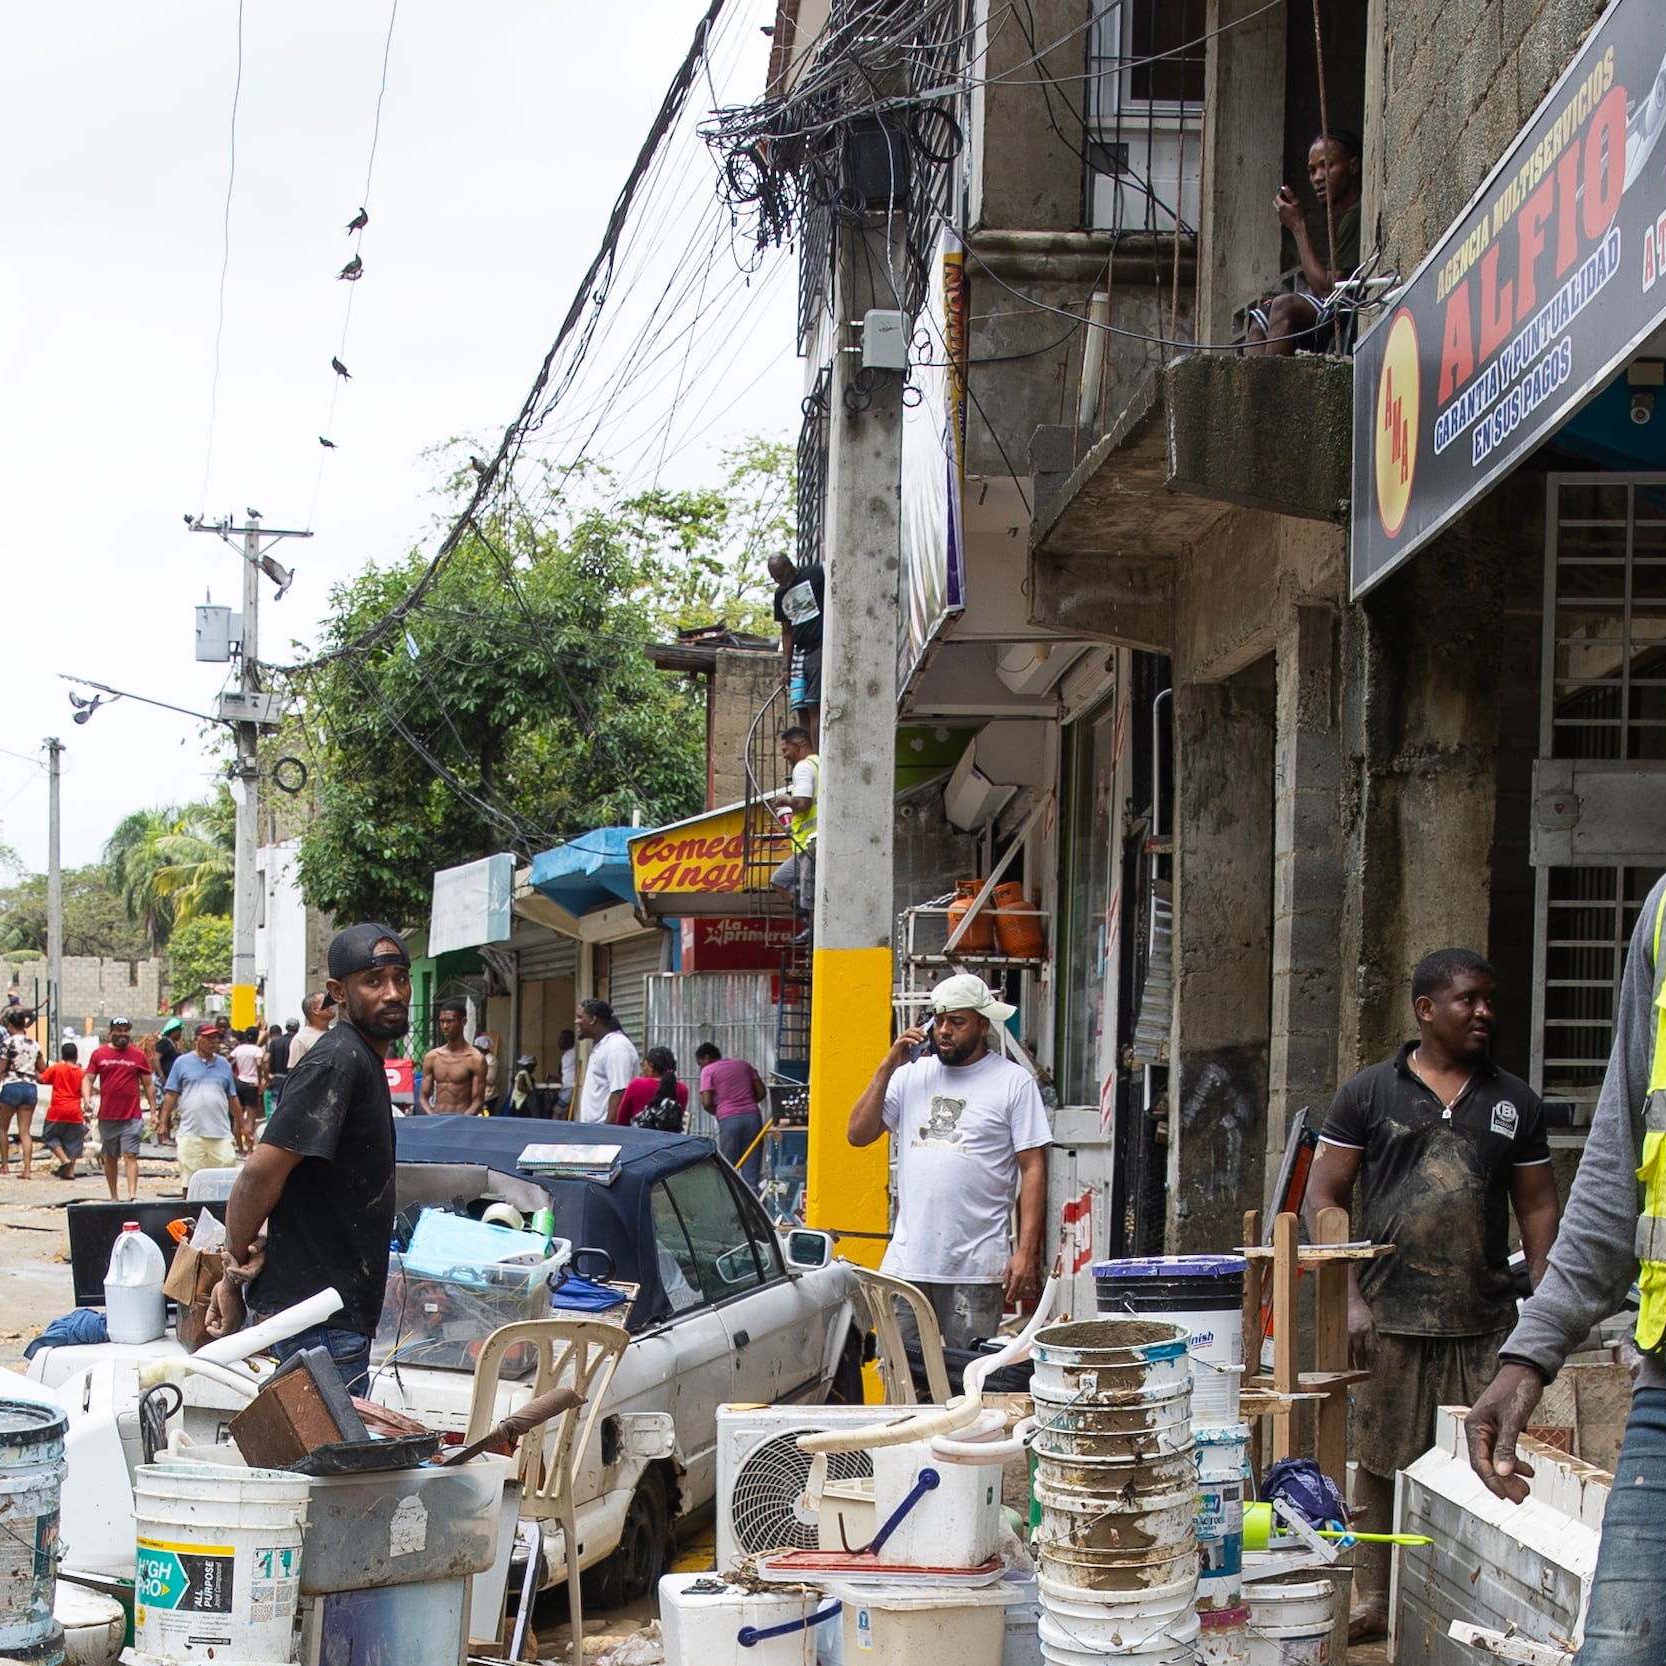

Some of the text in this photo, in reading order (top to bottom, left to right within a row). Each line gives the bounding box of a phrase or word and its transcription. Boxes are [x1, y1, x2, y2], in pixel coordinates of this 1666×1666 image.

[1437, 45, 1614, 304] AGENCIA MULTISERVICIOS
[1437, 85, 1628, 407] ALFIO
[1643, 225, 1655, 293] A
[1435, 226, 1621, 455] GARANTIA Y PUNTUALIDAD
[1472, 336, 1571, 467] EN SUS PAGOS
[724, 918, 741, 930] La
[724, 926, 792, 943] primera
[138, 1576, 162, 1597] PRO
[194, 1590, 204, 1608] ALL
[204, 1561, 215, 1608] PURPOSE
[213, 1562, 223, 1592] Compound
